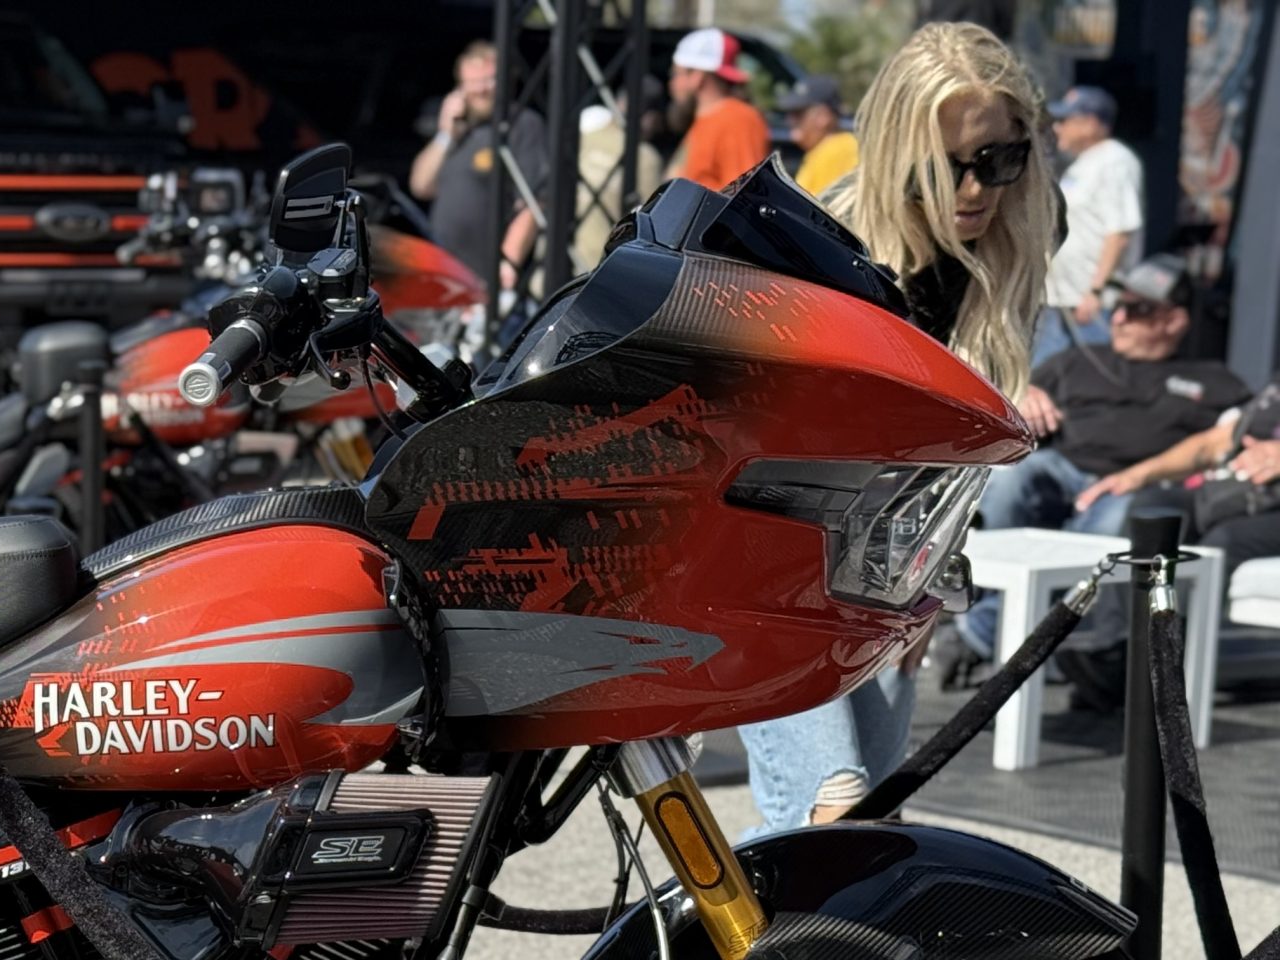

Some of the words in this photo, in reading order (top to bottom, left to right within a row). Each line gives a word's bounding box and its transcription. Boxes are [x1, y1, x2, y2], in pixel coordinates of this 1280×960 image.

[33, 679, 224, 734] HARLEY-
[75, 714, 275, 756] DAVIDSON
[311, 835, 385, 858] SE
